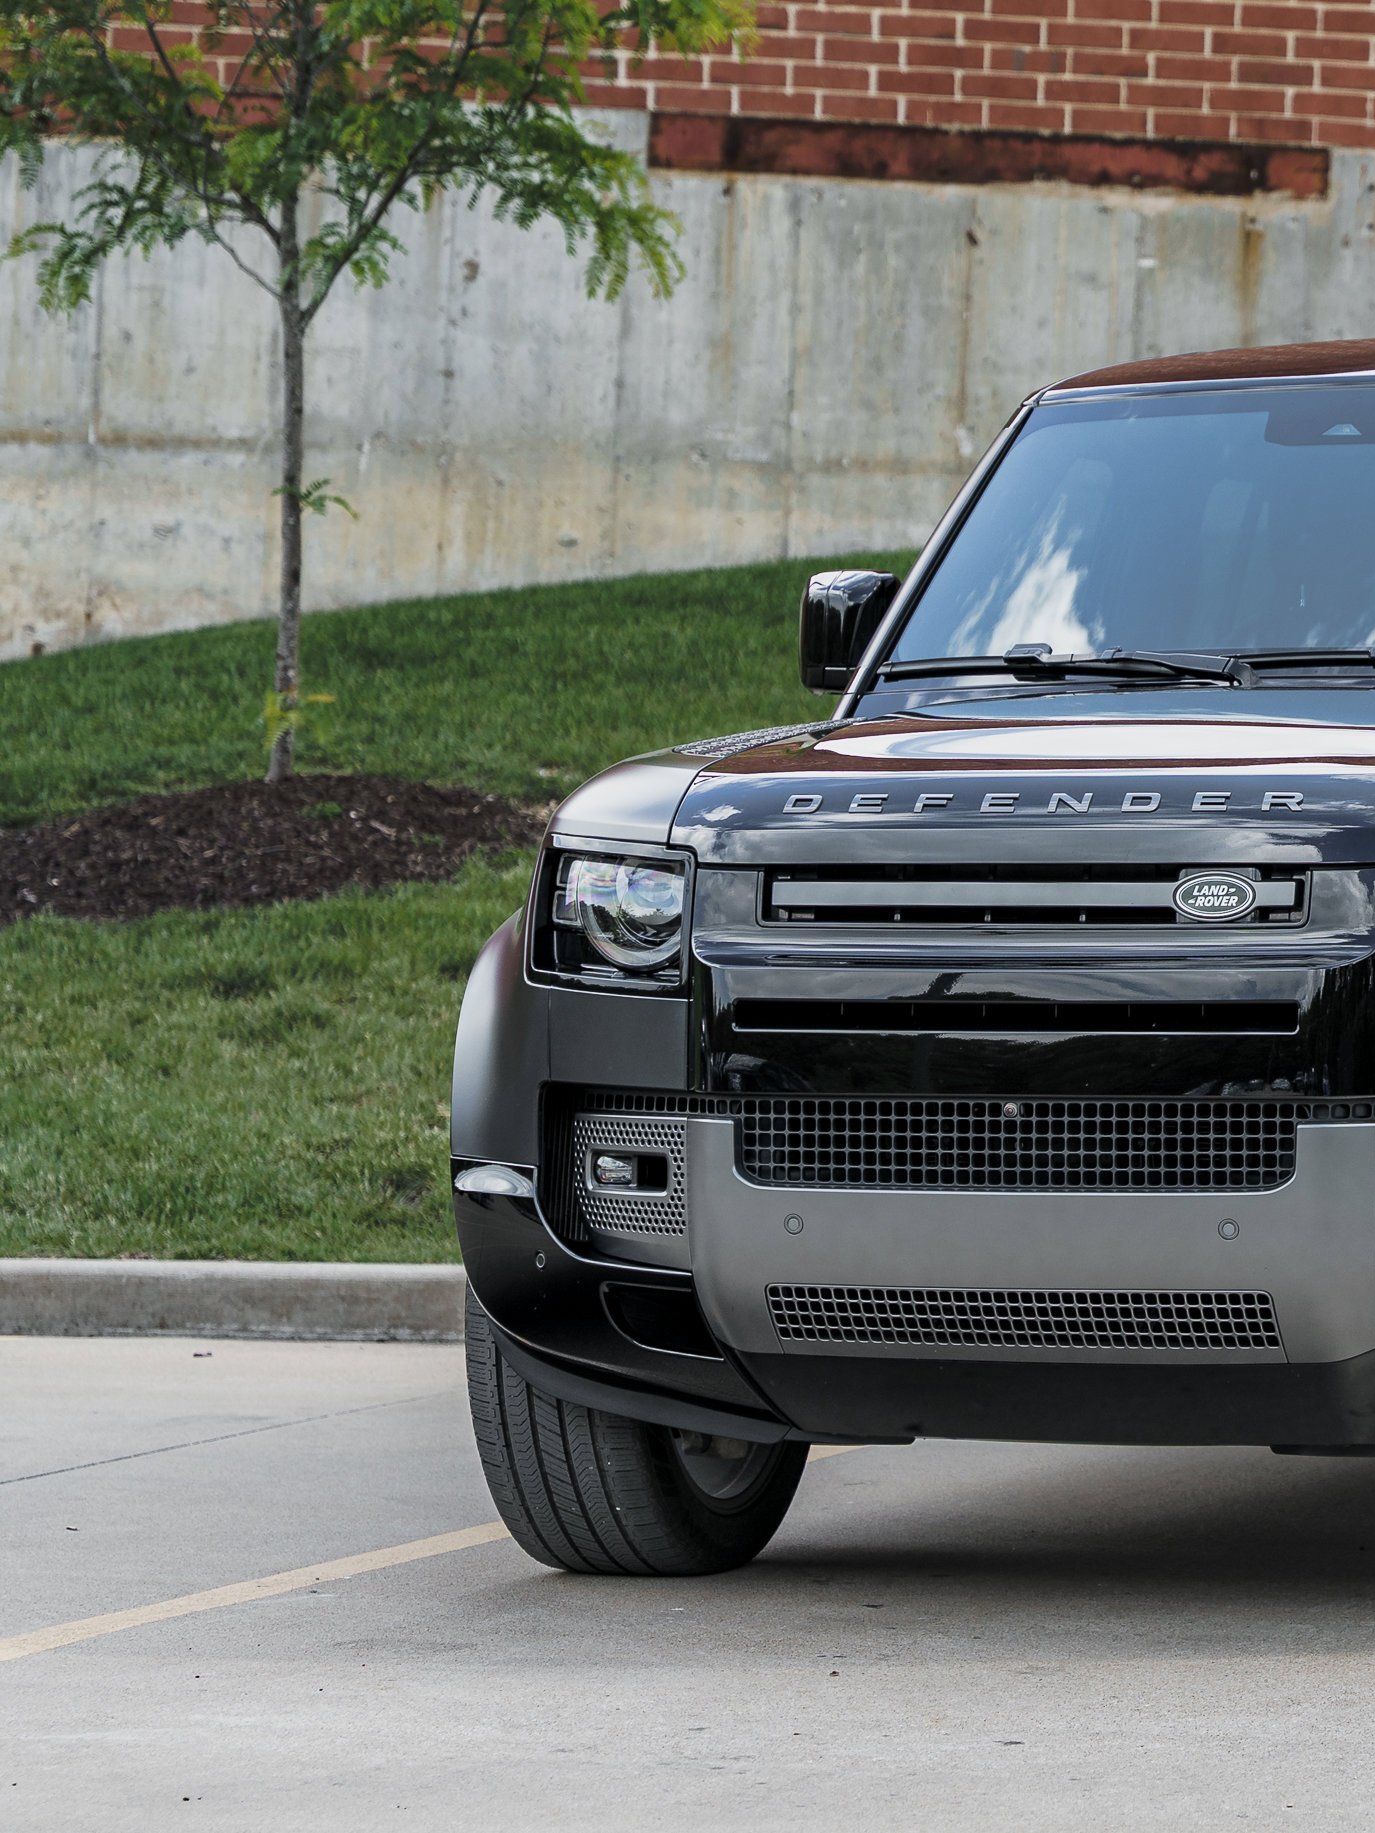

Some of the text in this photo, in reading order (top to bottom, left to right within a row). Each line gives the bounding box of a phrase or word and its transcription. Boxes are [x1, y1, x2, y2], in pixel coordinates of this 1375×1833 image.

[782, 791, 1304, 814] DEFENDER
[1192, 885, 1228, 896] LAND
[1195, 896, 1238, 907] ROVER
